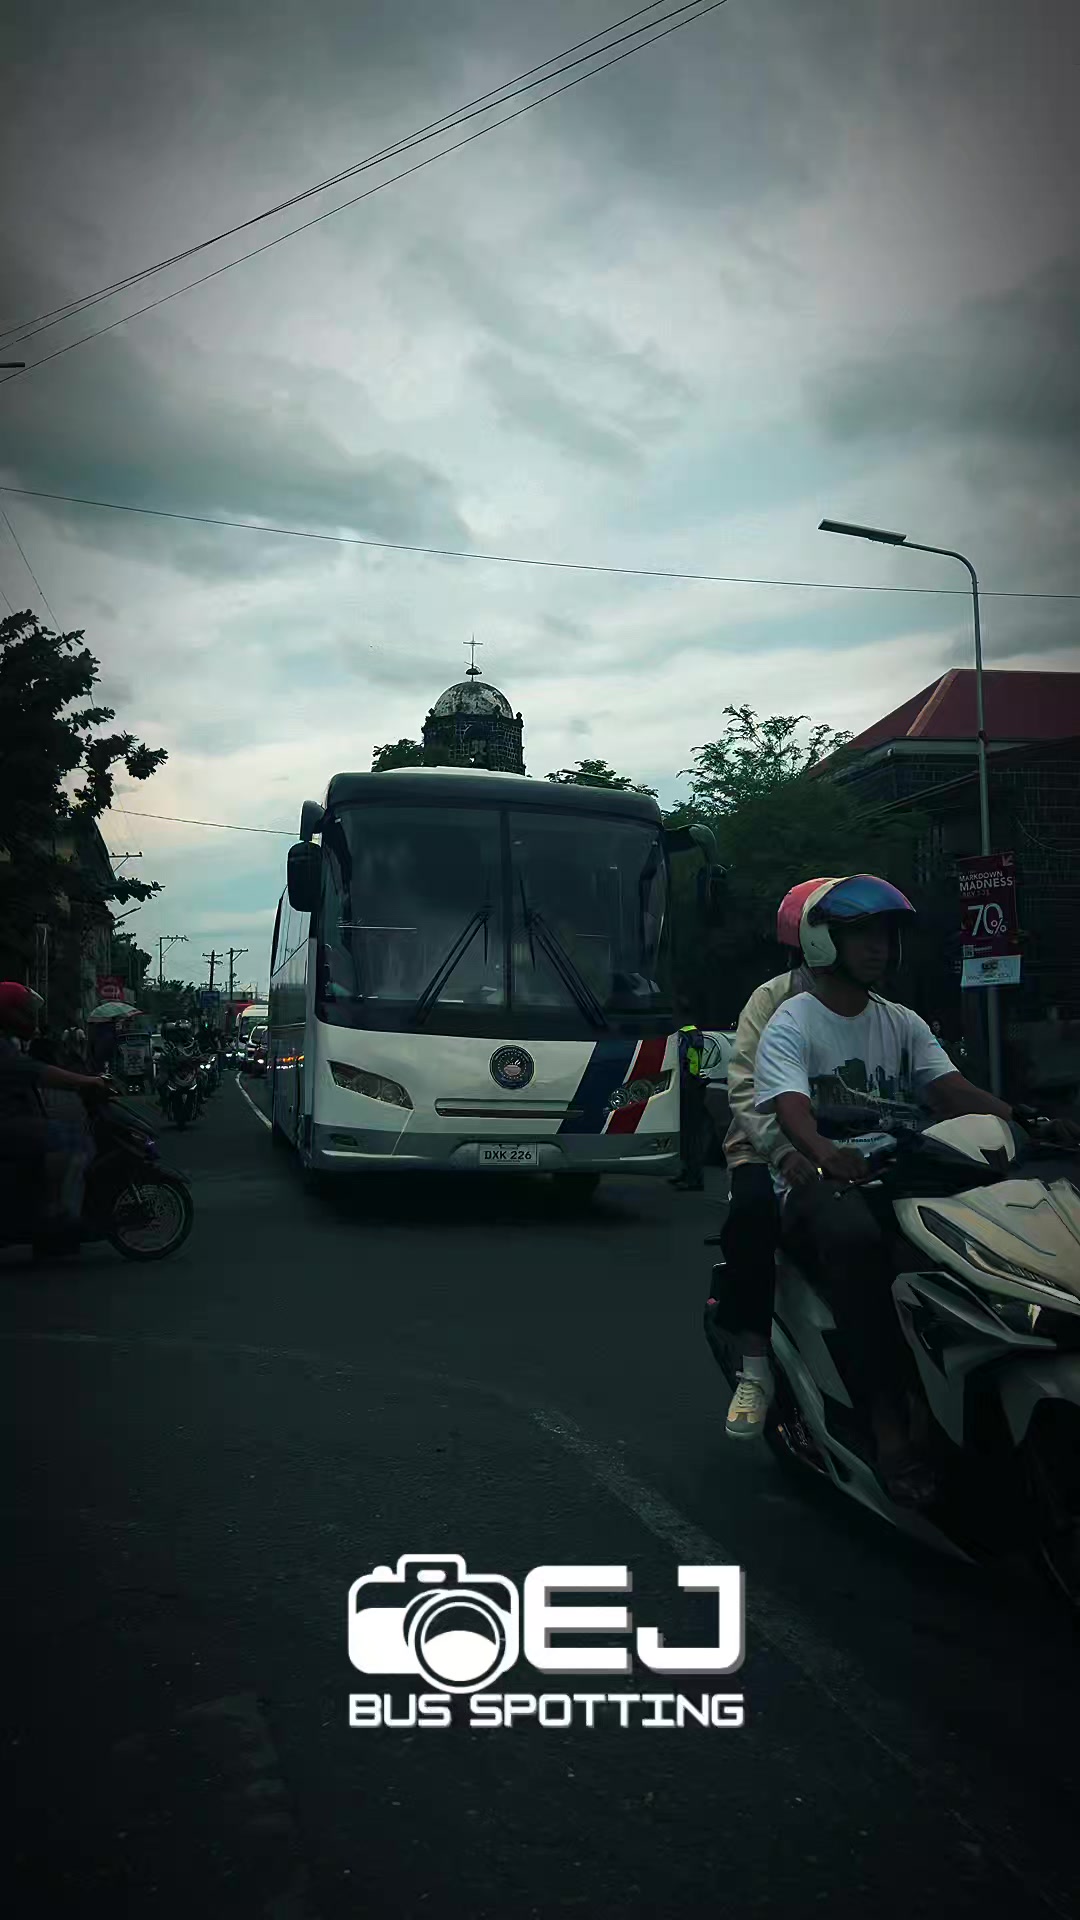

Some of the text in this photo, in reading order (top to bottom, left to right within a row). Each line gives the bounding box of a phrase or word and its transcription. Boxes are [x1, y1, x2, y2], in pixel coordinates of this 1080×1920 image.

[959, 871, 1003, 882] MARKDOWN
[959, 877, 1013, 892] MADNESS
[967, 902, 1007, 937] 70%
[485, 1150, 532, 1159] DXK 226
